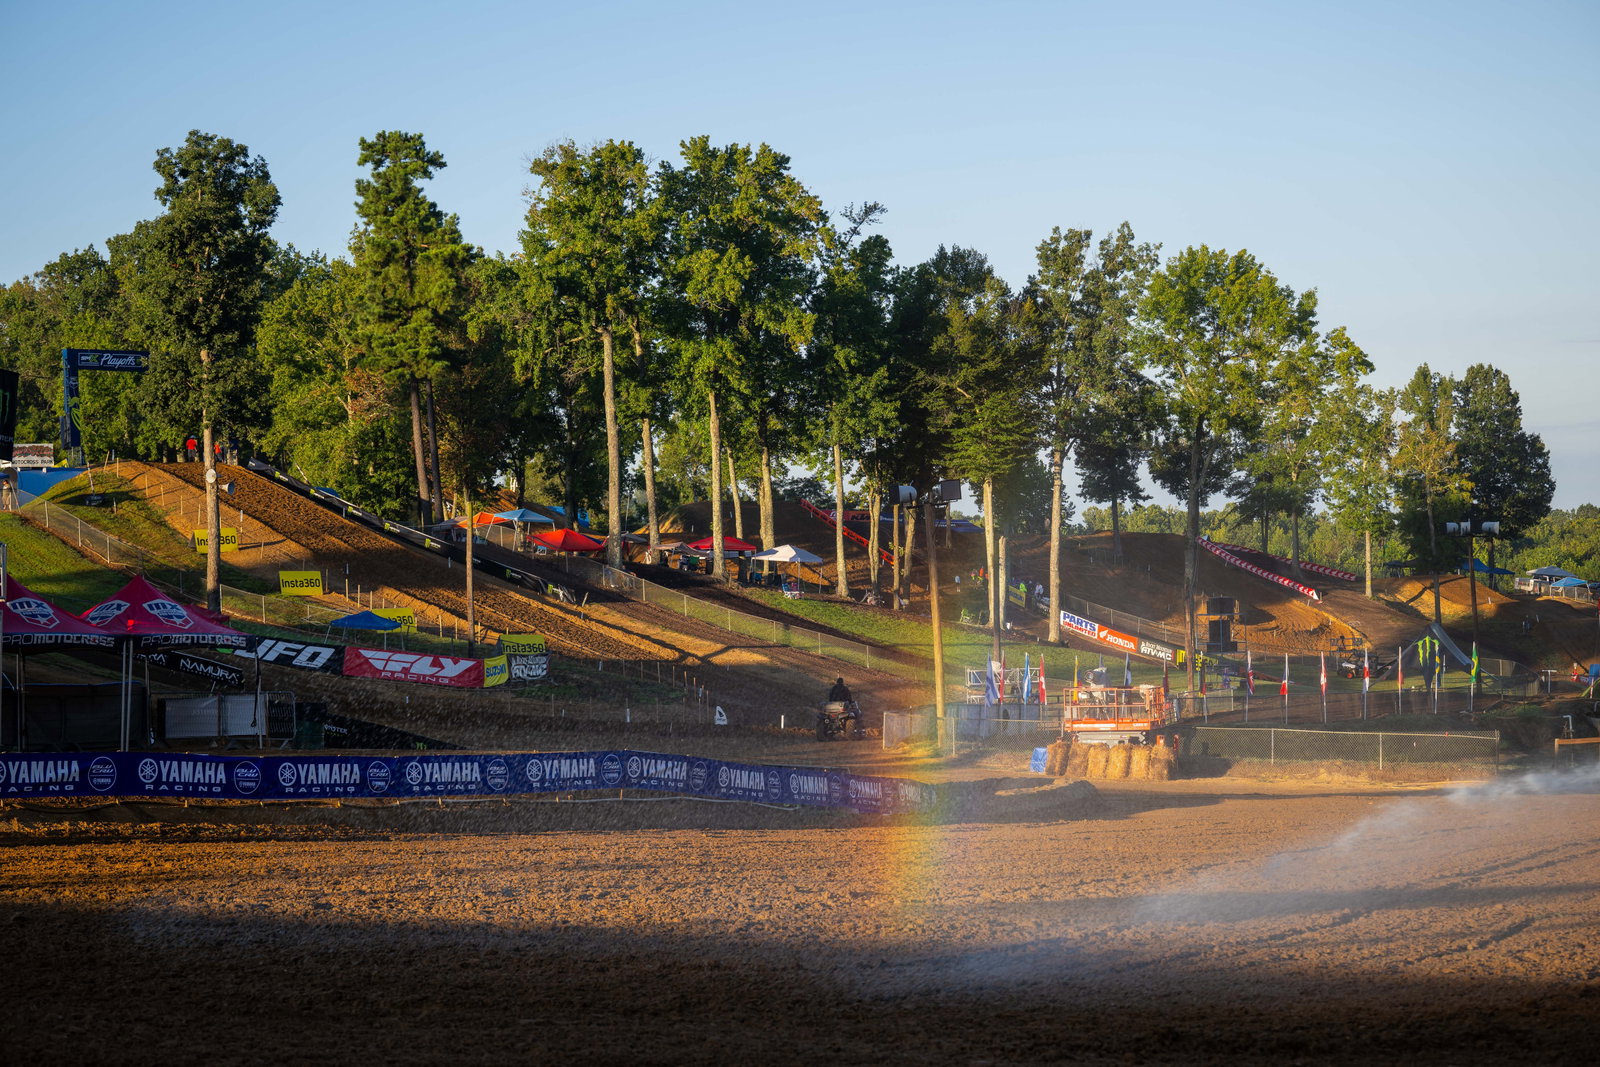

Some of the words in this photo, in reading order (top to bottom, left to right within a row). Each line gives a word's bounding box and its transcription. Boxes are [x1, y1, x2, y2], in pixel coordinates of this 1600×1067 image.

[100, 353, 136, 369] Playoffs
[281, 578, 321, 588] Insta360
[1063, 611, 1096, 632] PARTS
[1063, 620, 1096, 638] UNLIMITED
[502, 643, 544, 653] Insta360
[1106, 634, 1136, 650] HONDA
[180, 658, 239, 682] NAMURA
[381, 671, 449, 684] RACING
[8, 760, 80, 783] YAMAHA
[160, 761, 226, 784] YAMAHA
[298, 763, 360, 785] YAMAHA
[423, 761, 481, 783] YAMAHA
[544, 758, 596, 780] YAMAHA
[642, 759, 687, 780] YAMAHA
[145, 784, 222, 793] RACING
[413, 783, 477, 791] RACING
[631, 779, 684, 787] RACING
[730, 769, 765, 791] YAMAHA
[797, 775, 829, 795] YAMAHA
[721, 788, 763, 798] RACING
